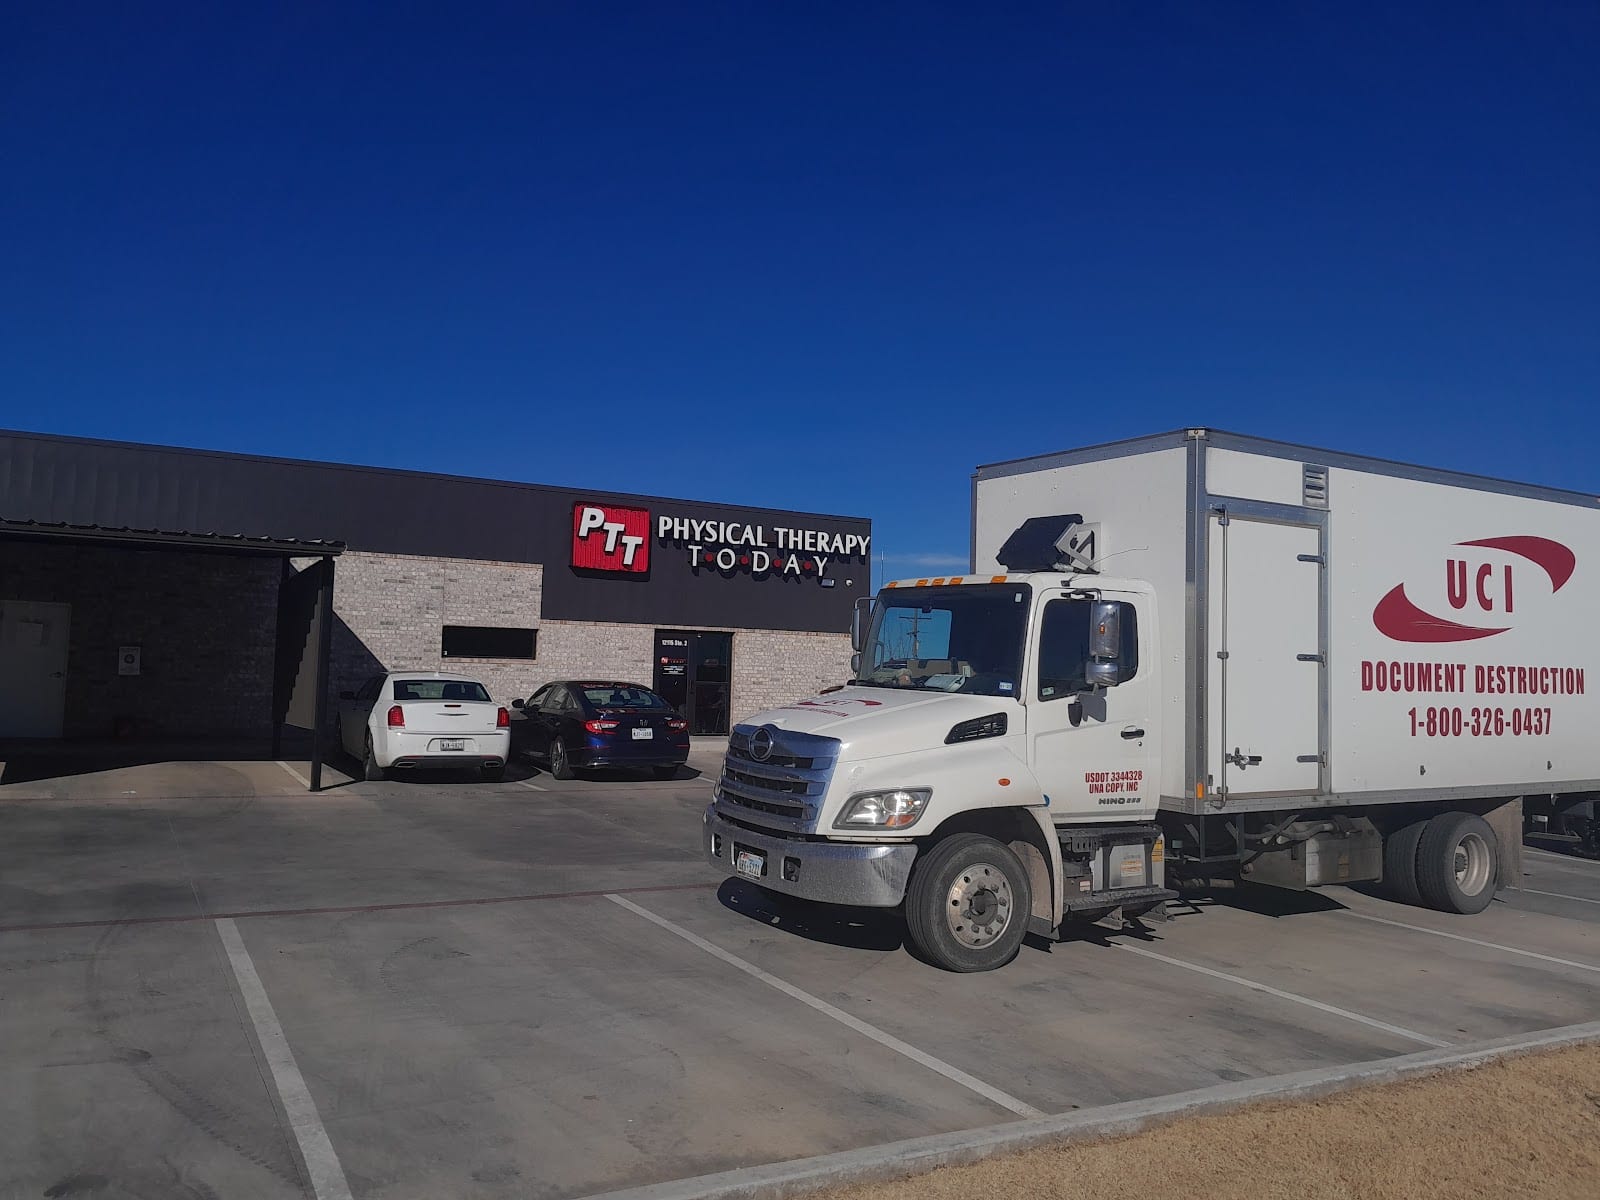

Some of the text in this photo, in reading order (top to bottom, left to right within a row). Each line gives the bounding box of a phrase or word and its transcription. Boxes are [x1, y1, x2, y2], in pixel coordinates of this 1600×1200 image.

[578, 507, 643, 565] PTT
[658, 516, 870, 555] PHYSICAL THERAPY
[1446, 559, 1513, 613] UCI
[1361, 660, 1585, 694] DOCUMENT DESTRUCTION
[1408, 706, 1551, 737] 1-800-326-0437
[1085, 770, 1143, 783] USDOT 3344328
[1089, 783, 1104, 794] UNA
[1126, 781, 1138, 791] INC
[1098, 797, 1126, 805] HINO
